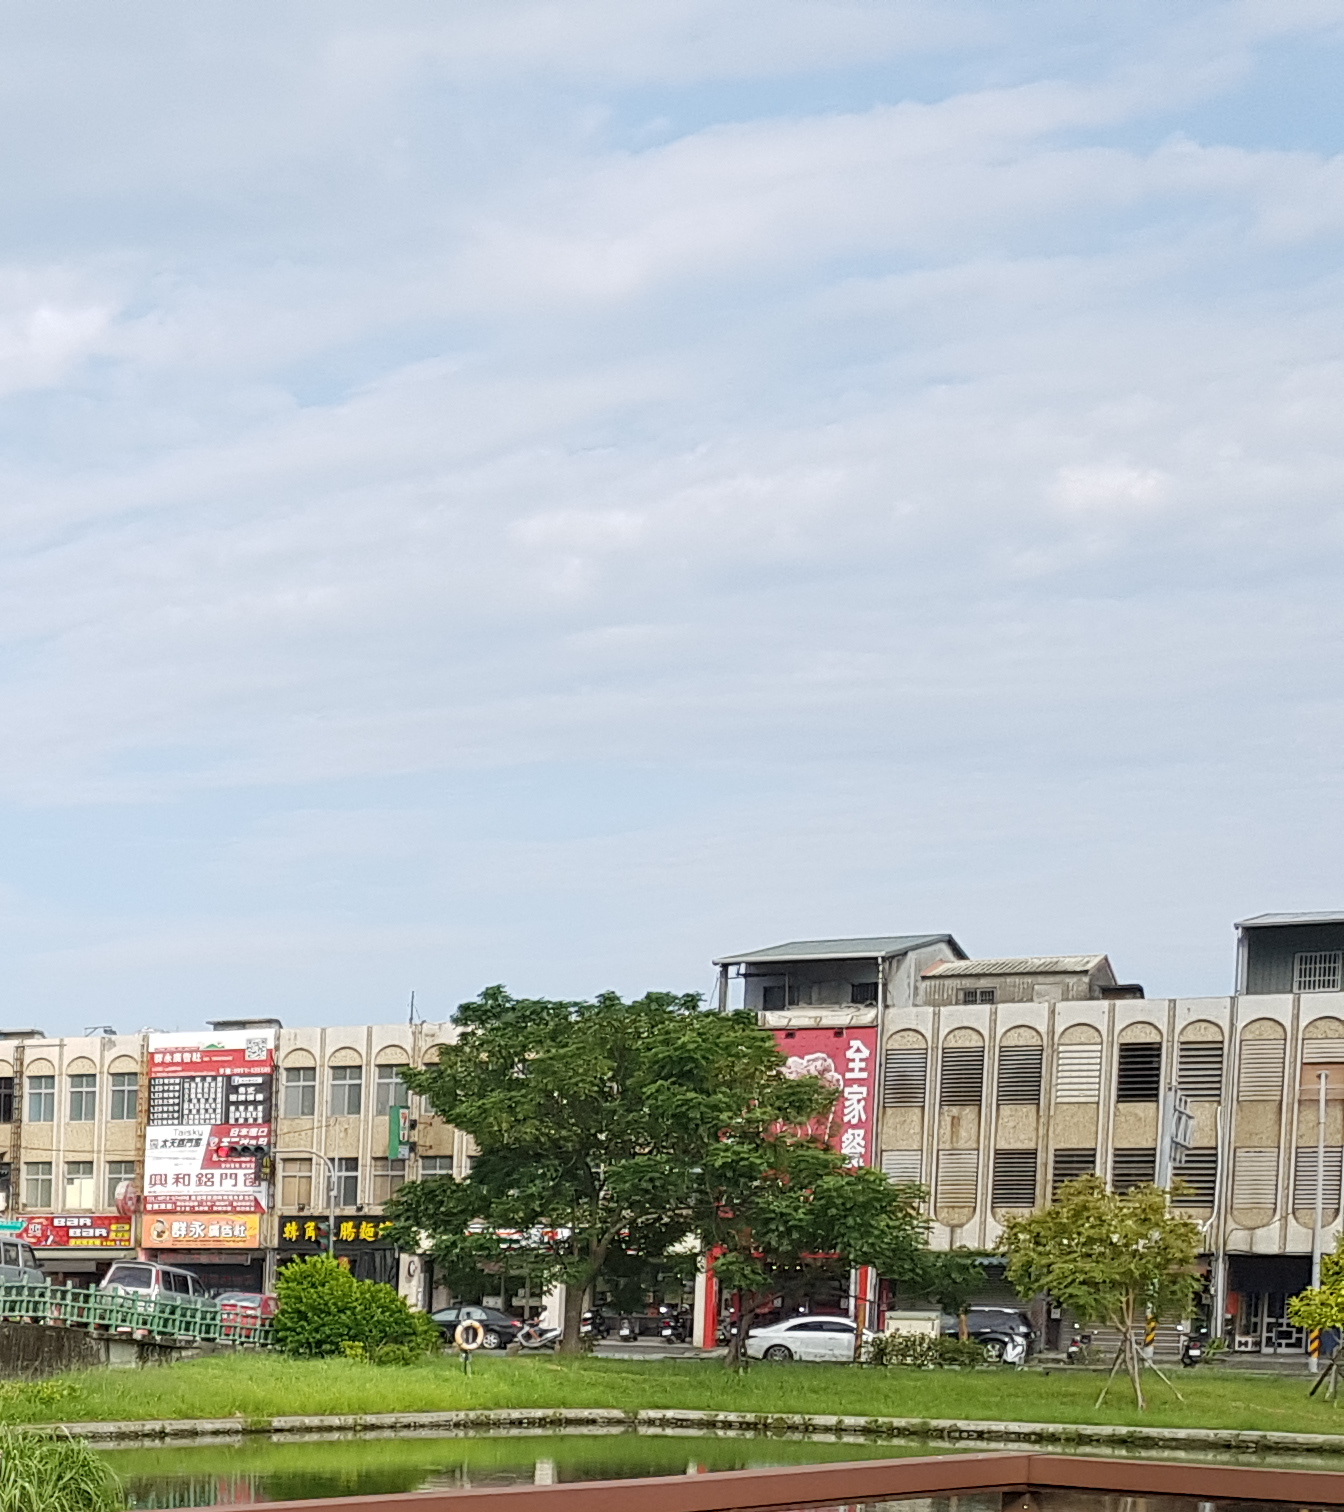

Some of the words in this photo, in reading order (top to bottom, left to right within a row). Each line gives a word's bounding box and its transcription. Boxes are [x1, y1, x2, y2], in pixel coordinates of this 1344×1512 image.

[173, 1128, 204, 1138] Taisky
[282, 1220, 394, 1242] 轉角腸麵
